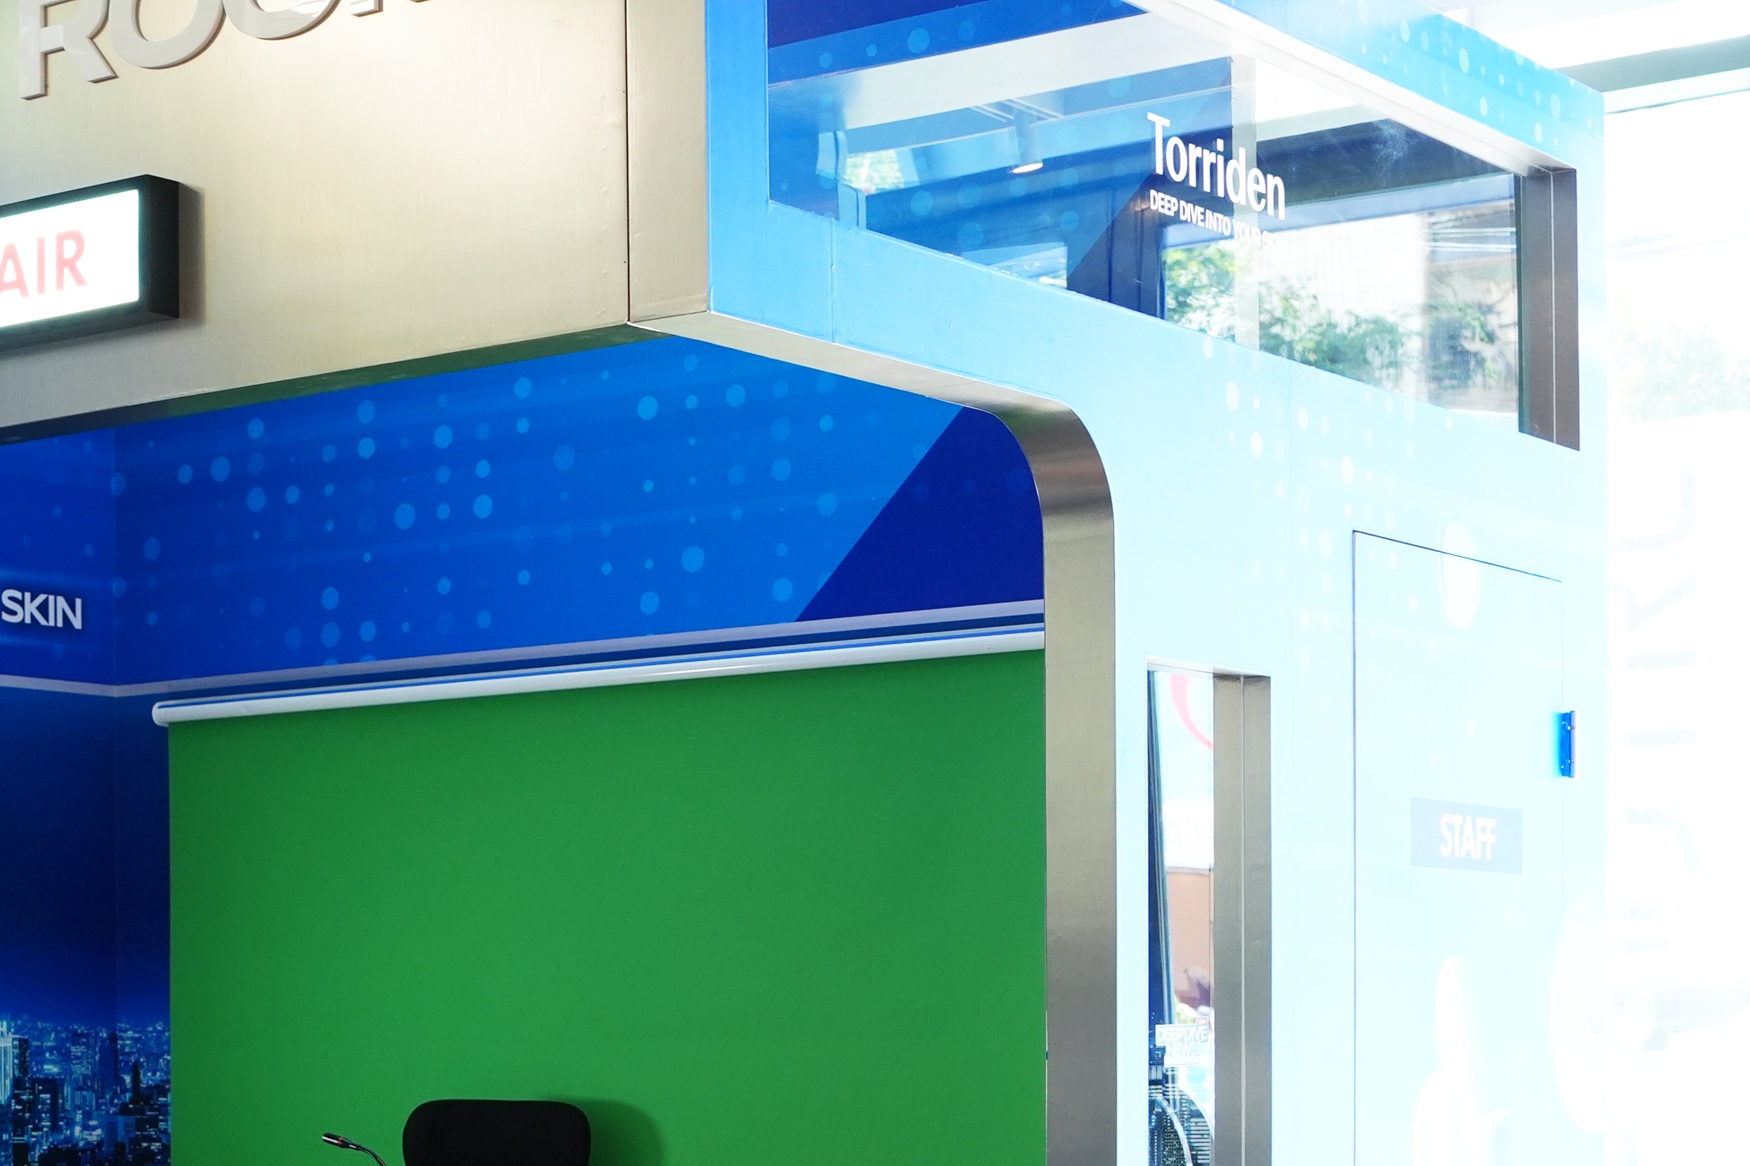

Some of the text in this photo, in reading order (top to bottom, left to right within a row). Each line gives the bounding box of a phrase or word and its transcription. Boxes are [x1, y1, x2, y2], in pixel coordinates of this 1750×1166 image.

[19, 0, 440, 100] RO
[1147, 112, 1285, 221] Torriden
[1150, 189, 1179, 217] DEEP
[1180, 200, 1205, 227] DIVE
[1206, 209, 1232, 237] INTO
[1232, 218, 1261, 247] YOUR
[0, 588, 83, 630] SKIN
[1439, 813, 1497, 861] STAFF
